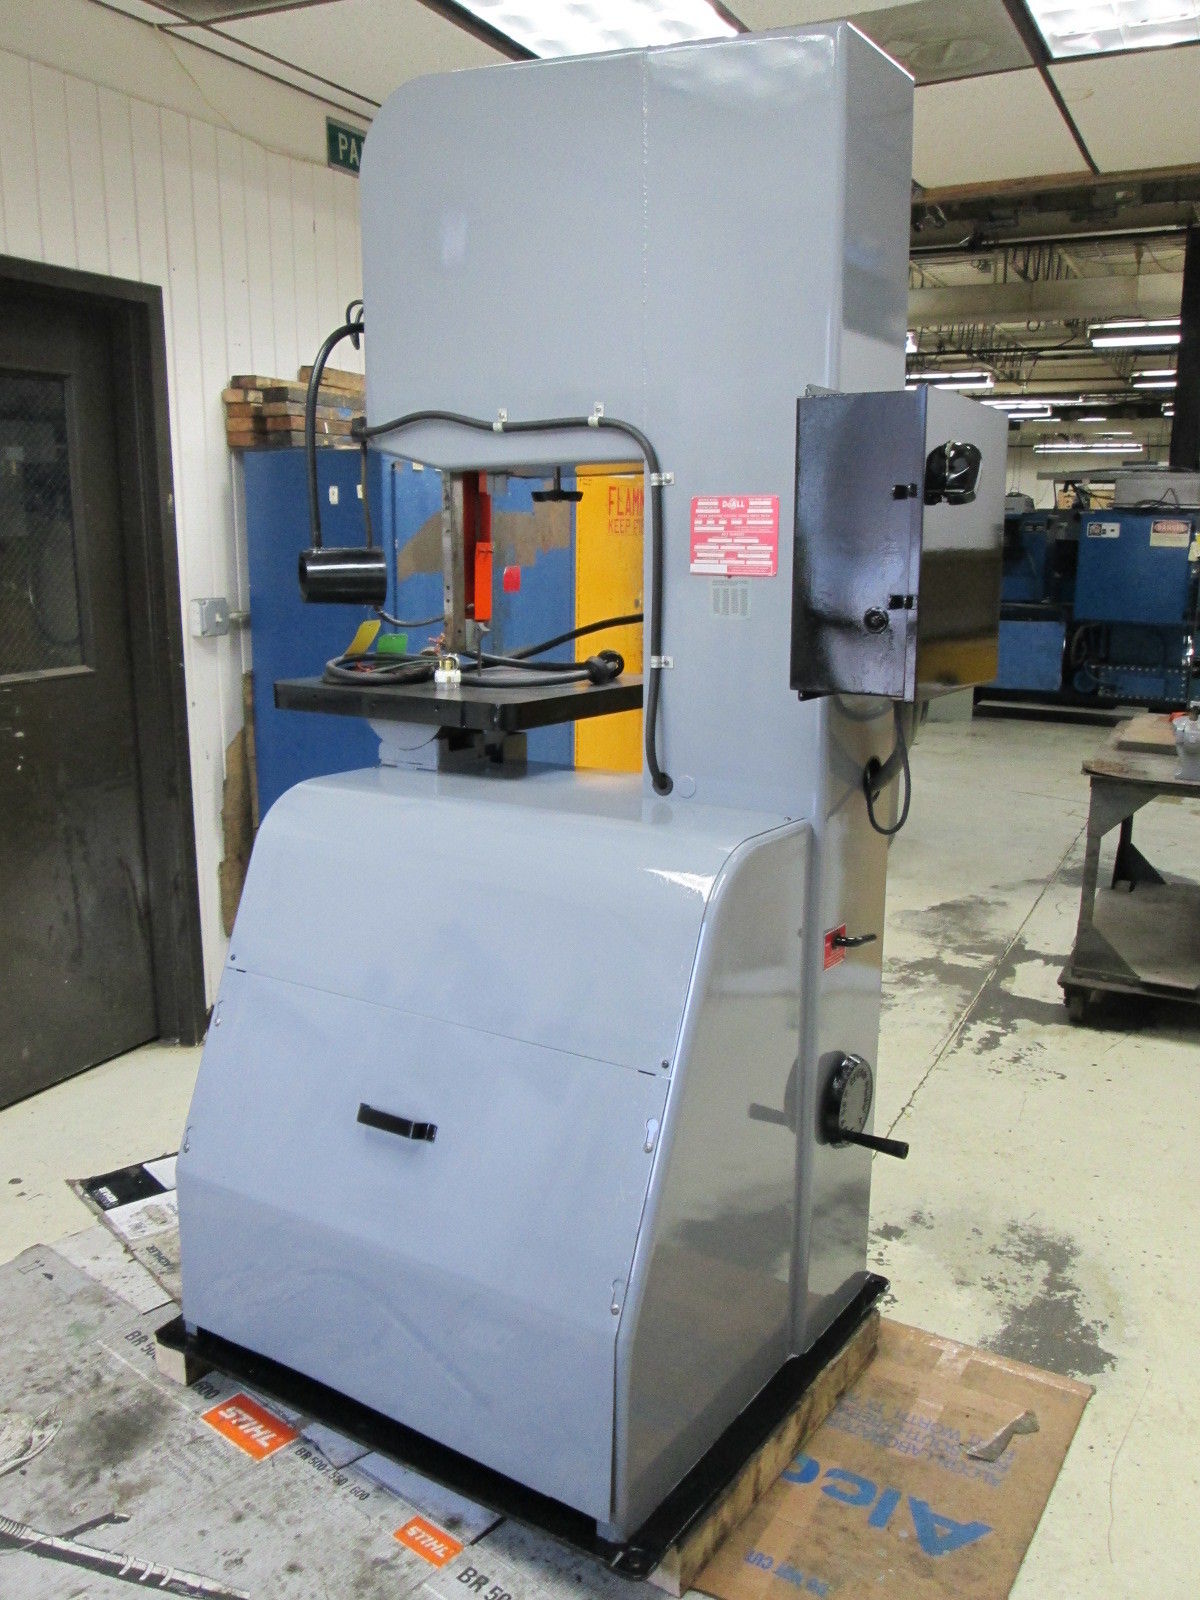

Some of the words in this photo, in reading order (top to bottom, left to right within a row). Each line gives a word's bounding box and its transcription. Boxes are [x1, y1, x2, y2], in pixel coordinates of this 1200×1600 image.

[338, 132, 363, 167] PA
[125, 1330, 149, 1347] BR
[217, 1406, 277, 1449] STIHL
[294, 1447, 312, 1461] BR
[406, 1525, 448, 1559] STIHL
[456, 1566, 490, 1593] BR
